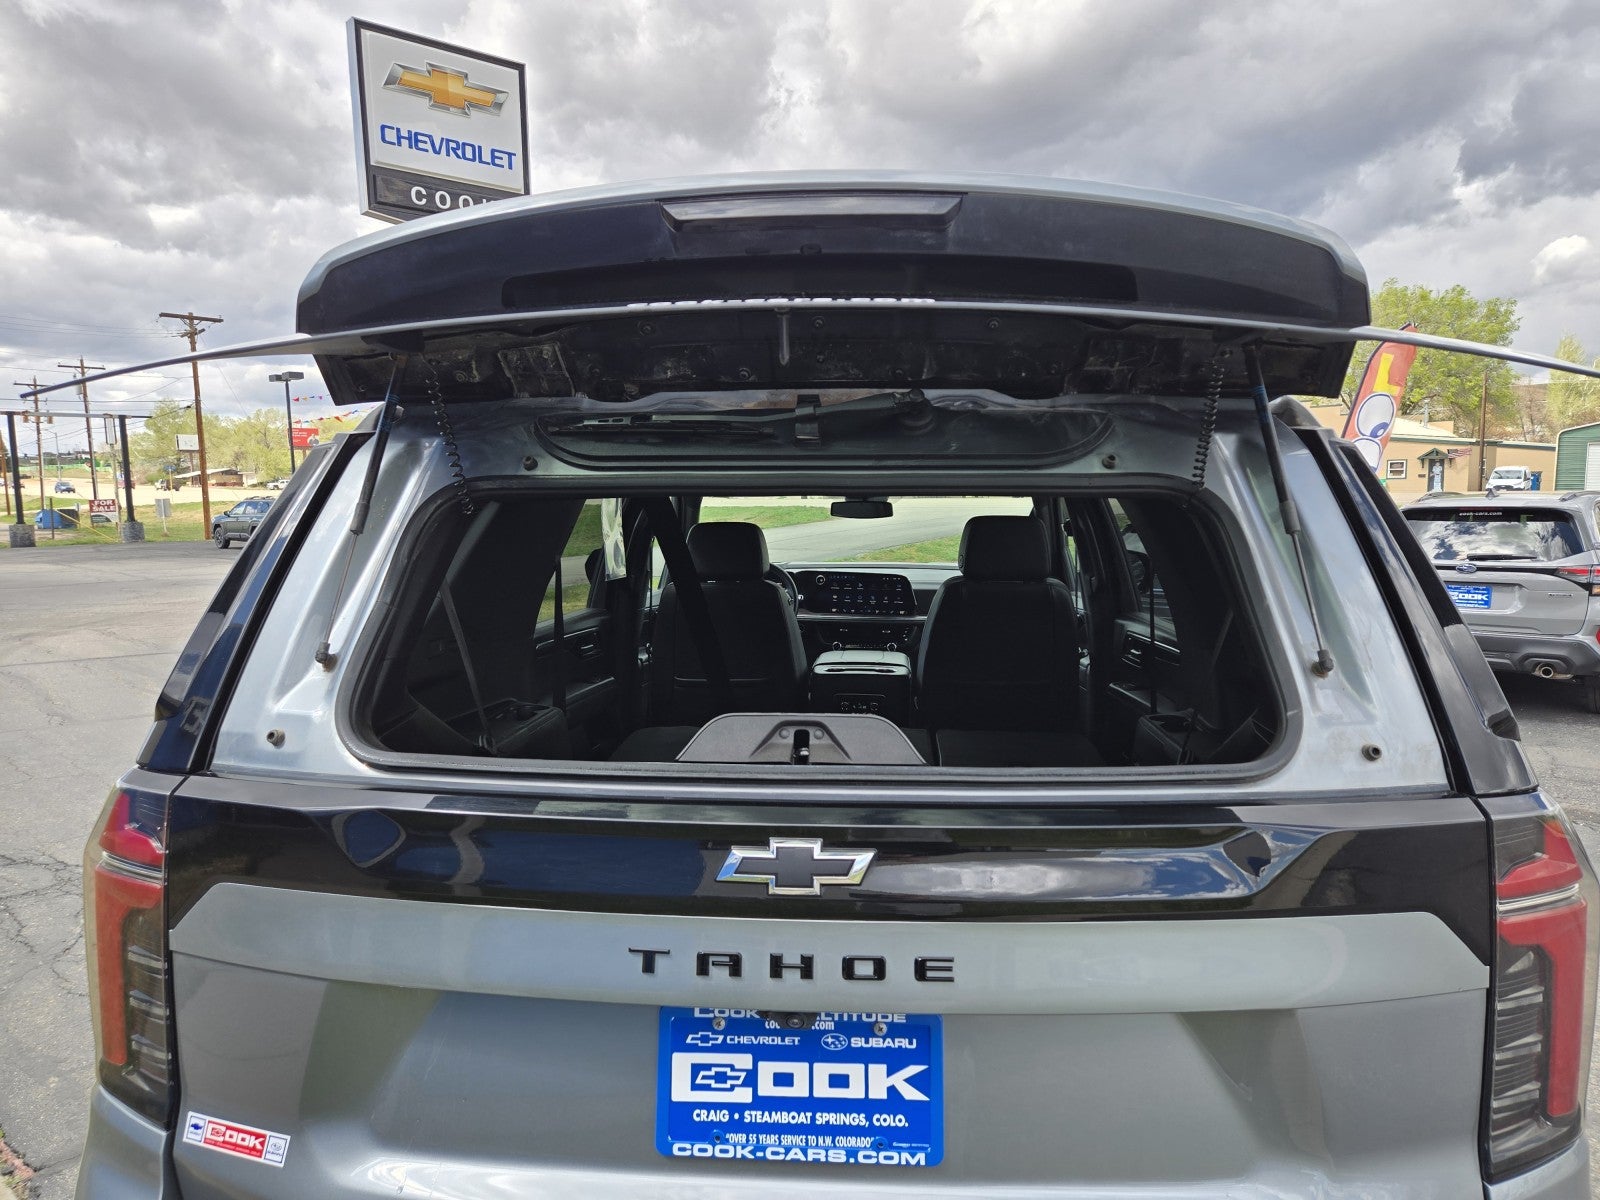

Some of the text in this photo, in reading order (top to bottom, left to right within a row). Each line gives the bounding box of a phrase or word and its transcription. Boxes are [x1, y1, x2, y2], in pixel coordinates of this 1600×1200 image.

[380, 124, 517, 170] CHEVROLET
[411, 186, 494, 209] COO
[628, 947, 955, 982] TAHOE
[816, 1011, 907, 1023] LTITUDE
[726, 1034, 800, 1046] CHEVROLET
[850, 1037, 917, 1049] SUBARU
[671, 1052, 931, 1104] COOK
[692, 1109, 909, 1128] CRAIG STEAMBOAT SPRINGS, COLO.
[205, 1123, 266, 1150] COOK
[749, 1133, 757, 1144] 55
[759, 1134, 779, 1145] YEARS
[781, 1134, 806, 1146] SERVICE
[807, 1135, 817, 1147] TO
[818, 1135, 834, 1147] N.W.
[671, 1143, 927, 1167] COOK-CARS.COM
